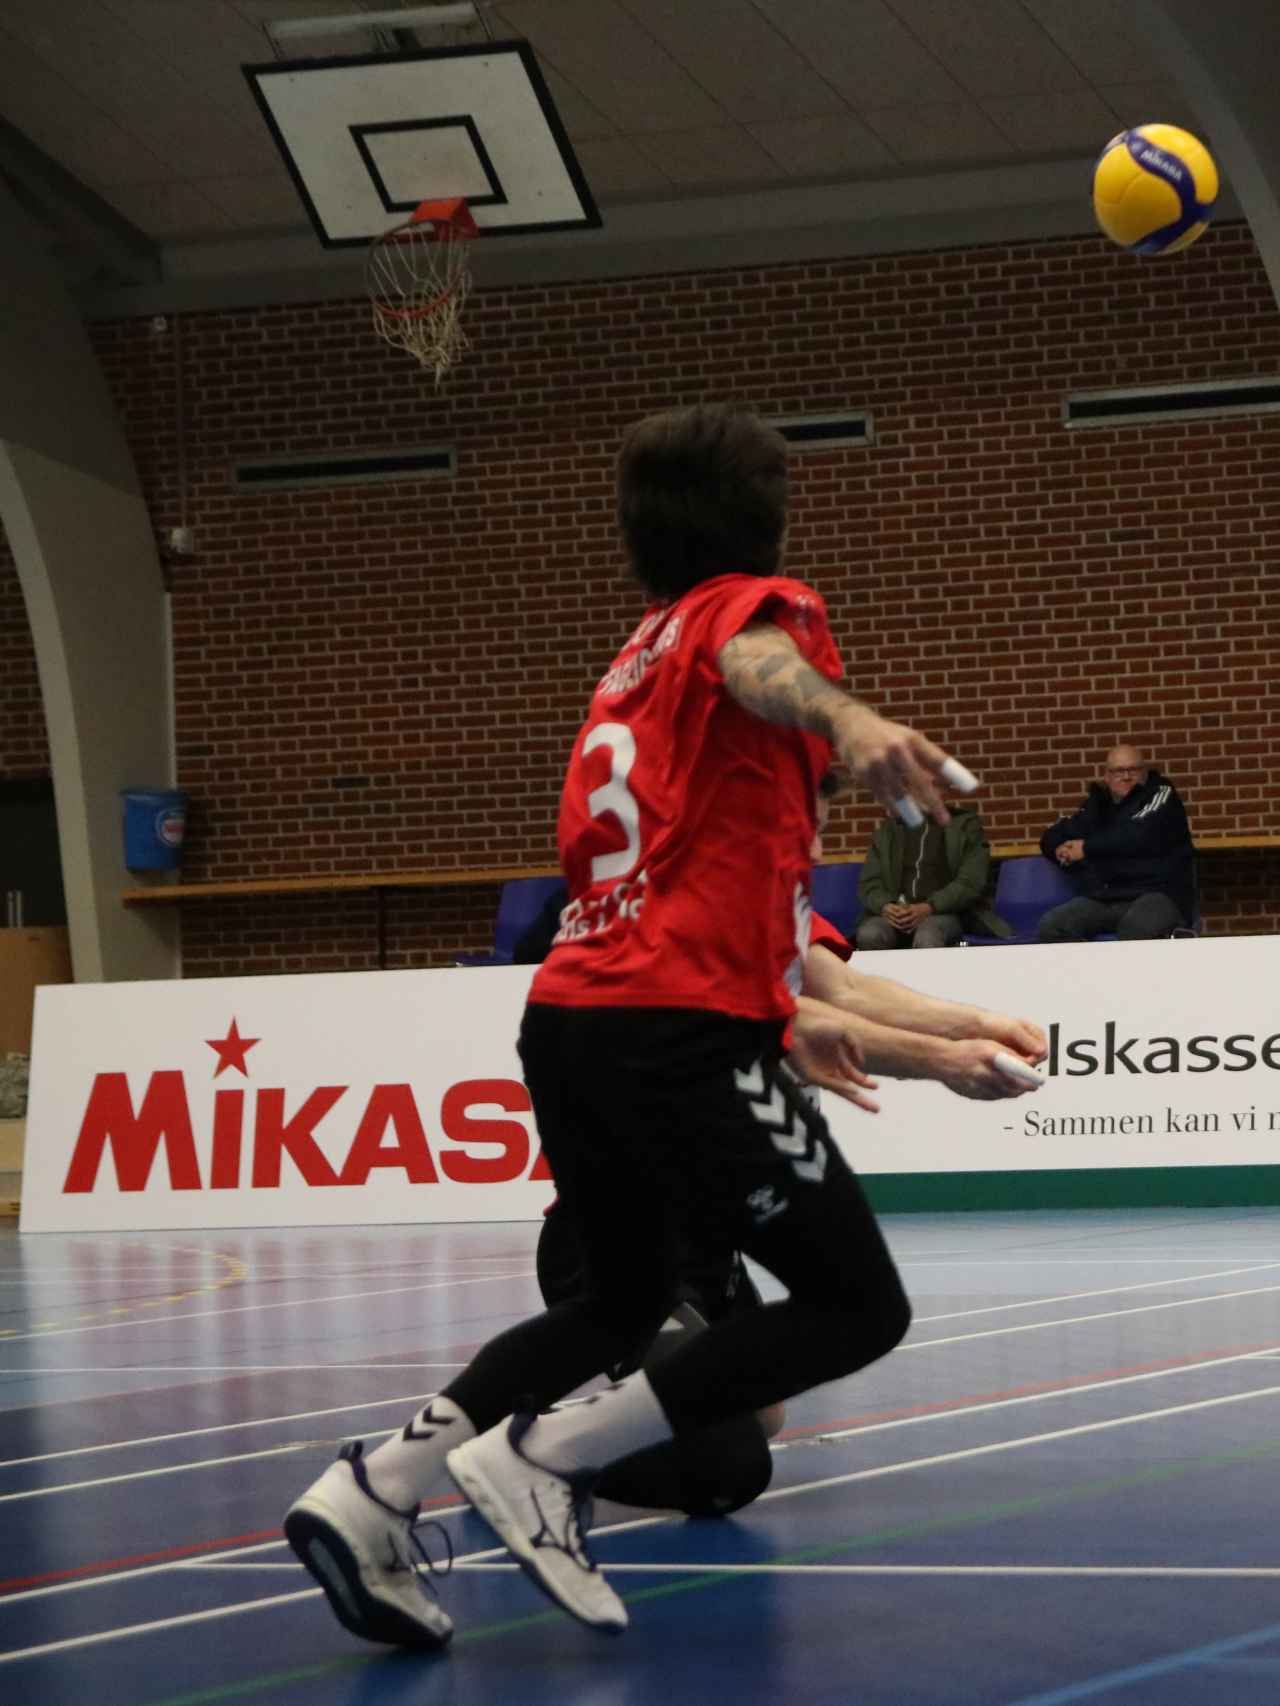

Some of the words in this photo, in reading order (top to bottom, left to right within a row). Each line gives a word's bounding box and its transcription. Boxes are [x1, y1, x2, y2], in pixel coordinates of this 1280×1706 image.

[581, 722, 640, 882] 3
[62, 1070, 554, 1194] MIKAS
[1024, 1110, 1155, 1137] Sammen
[1166, 1107, 1220, 1133] kan
[1231, 1105, 1256, 1131] vi
